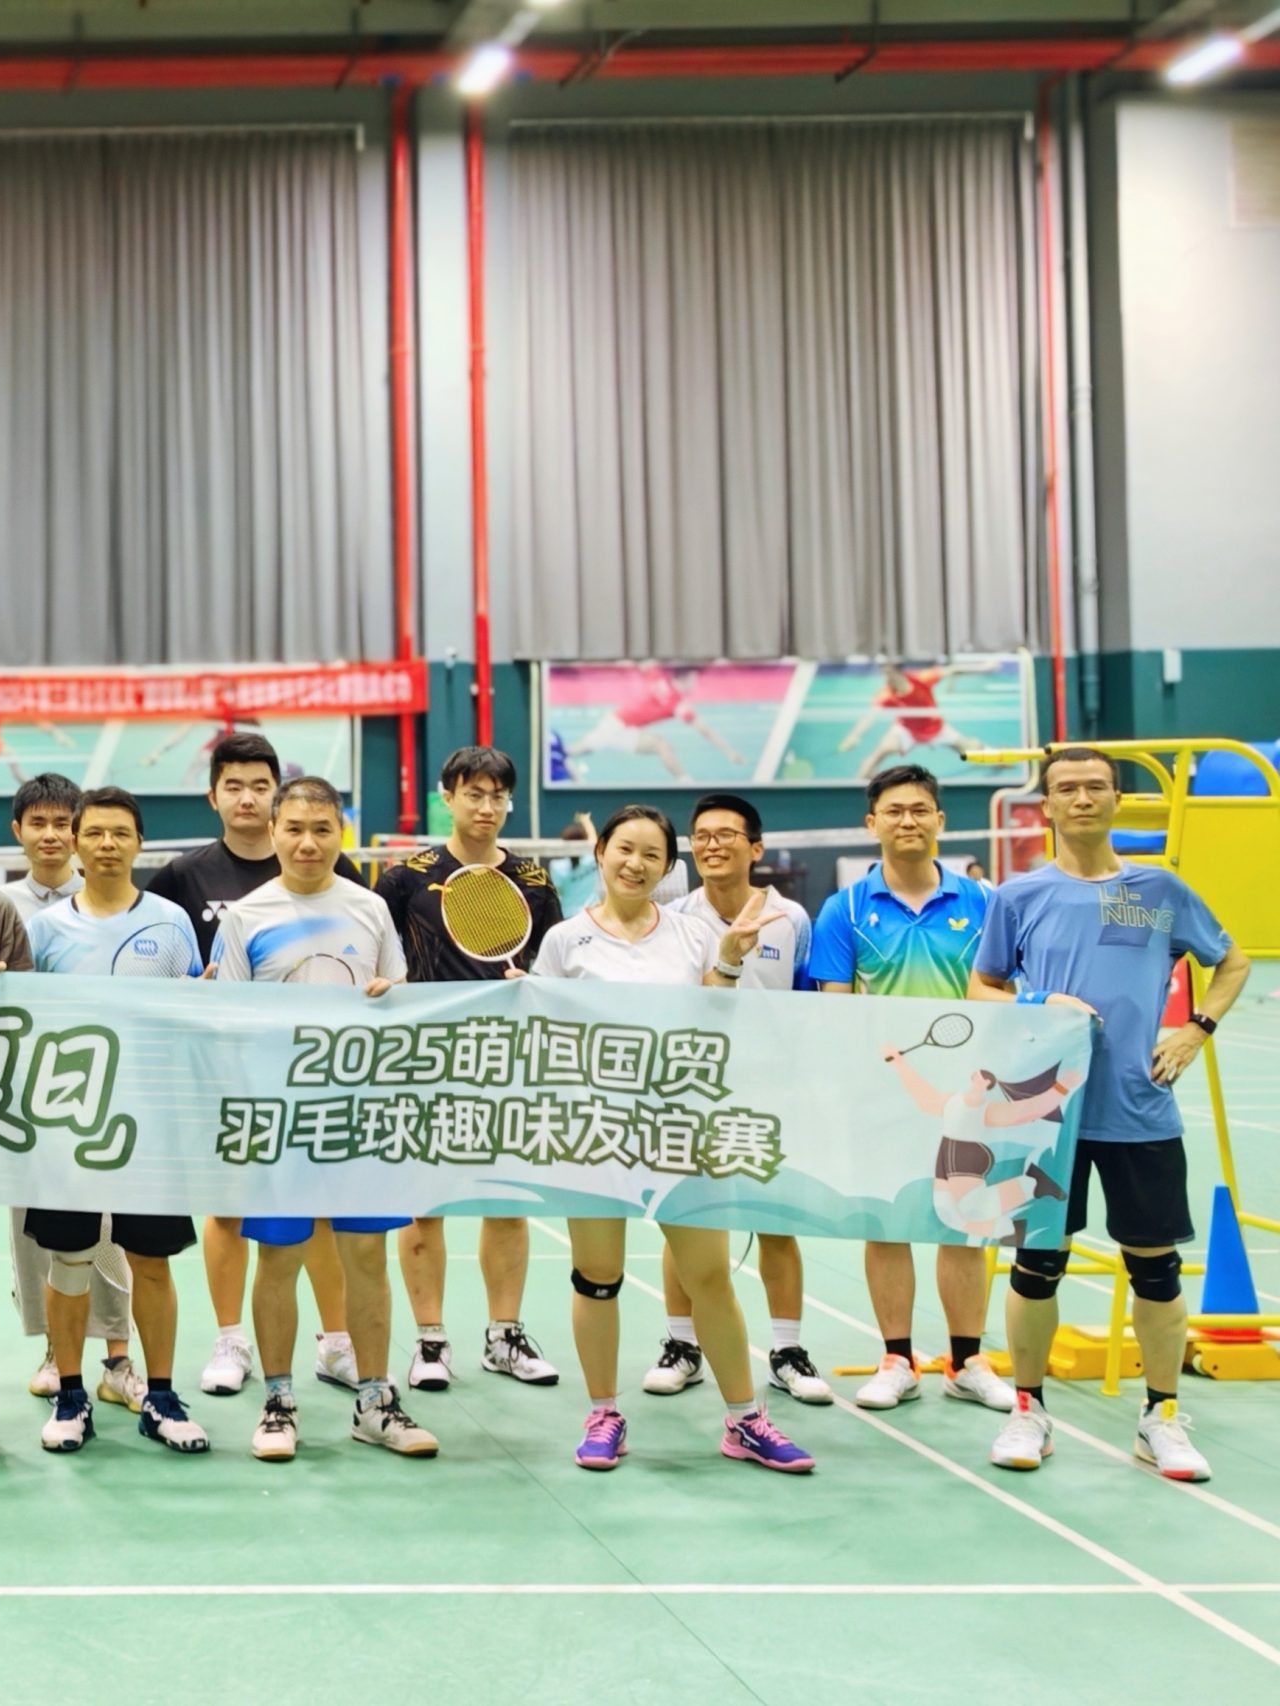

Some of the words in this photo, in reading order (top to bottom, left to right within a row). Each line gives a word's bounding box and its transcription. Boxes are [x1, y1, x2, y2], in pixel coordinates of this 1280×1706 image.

[1101, 903, 1176, 934] NING
[286, 1014, 734, 1101] 2025萌恒国贸
[215, 1091, 788, 1184] 羽毛球趣味友谊赛
